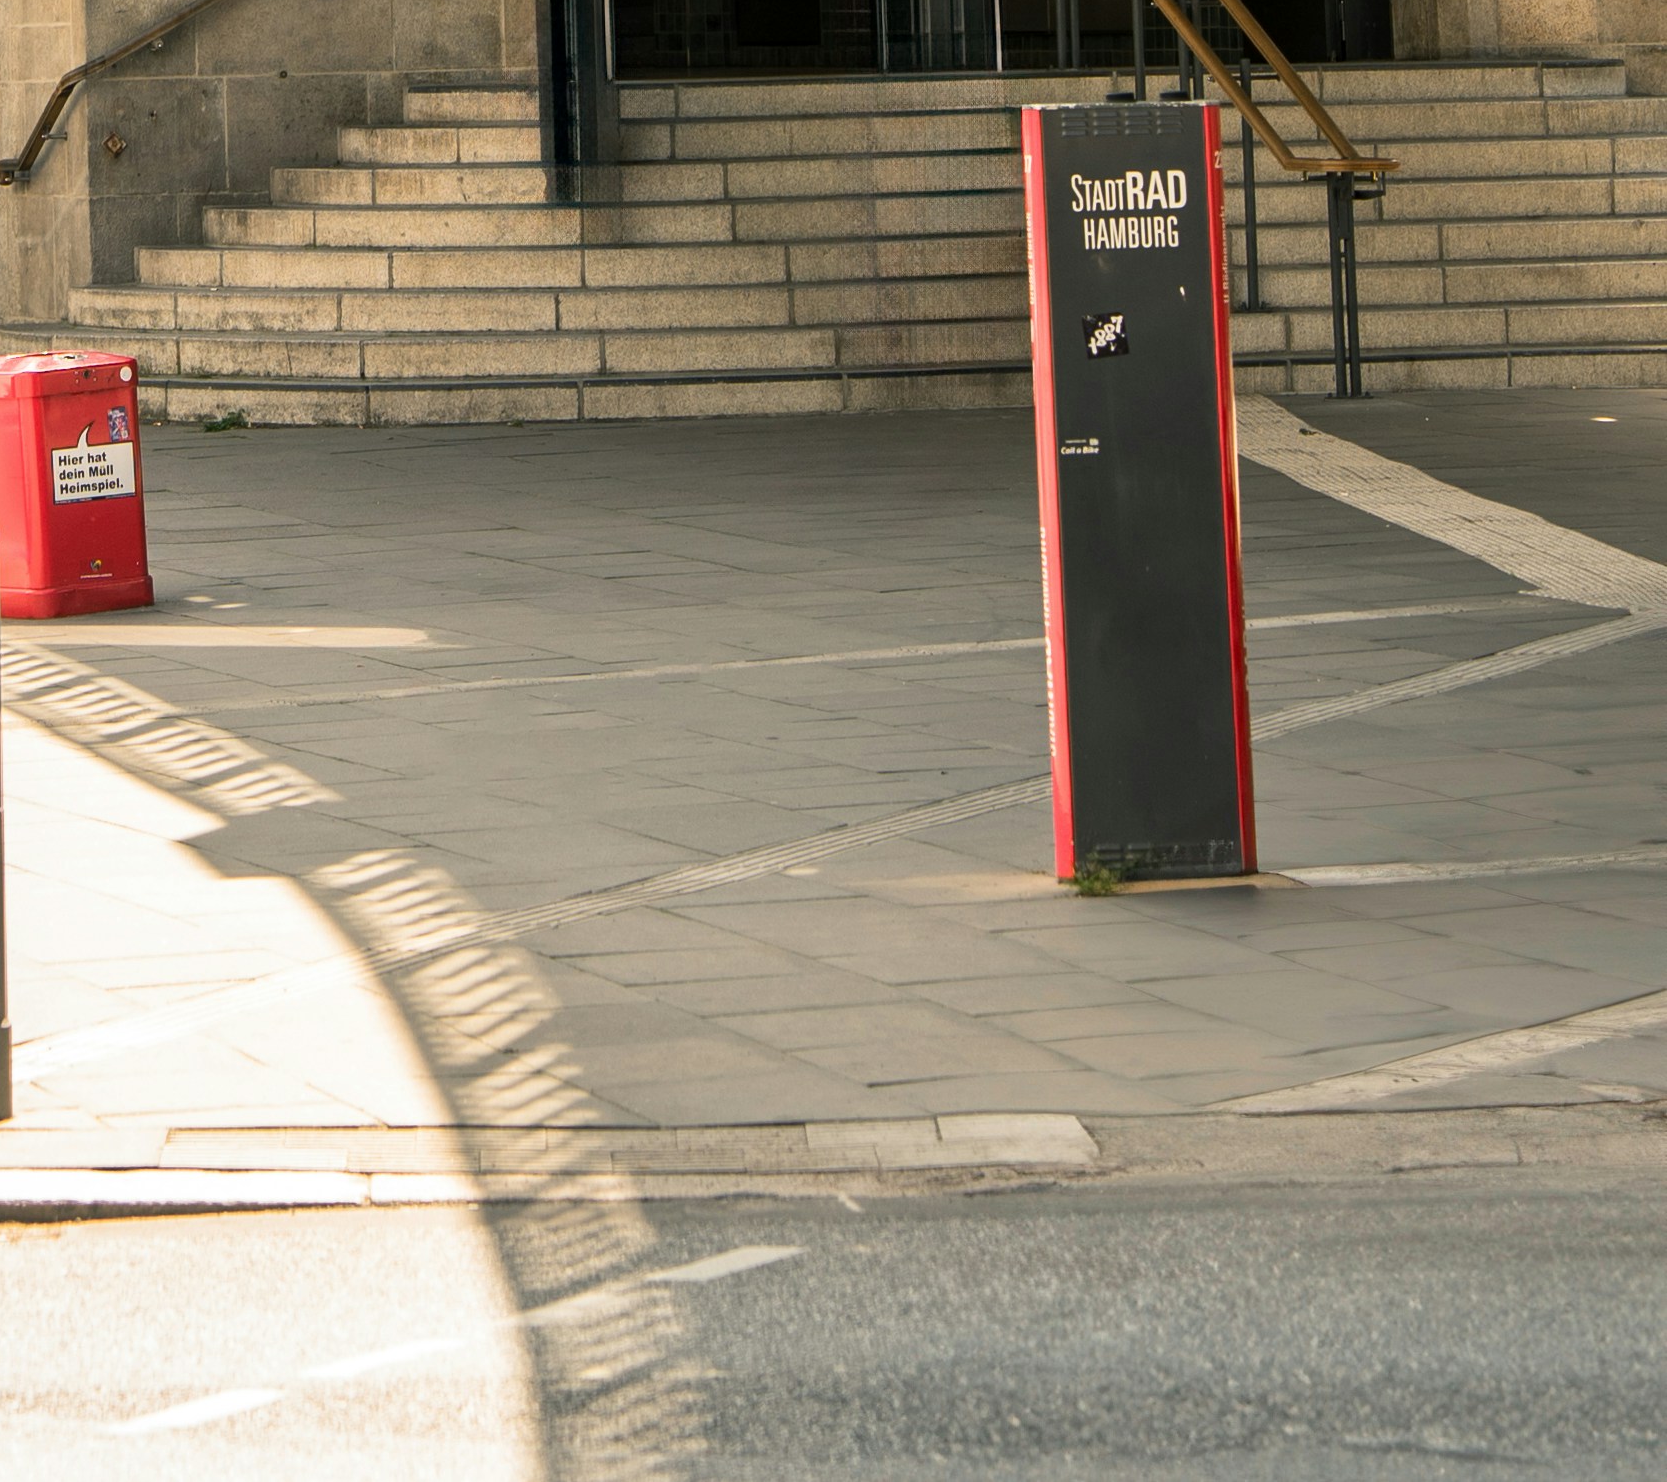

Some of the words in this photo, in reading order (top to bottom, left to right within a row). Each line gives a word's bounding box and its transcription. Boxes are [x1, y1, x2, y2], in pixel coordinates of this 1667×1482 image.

[1083, 215, 1179, 250] HAMBURG
[58, 455, 83, 466] Hier
[87, 452, 106, 463] hat
[59, 468, 85, 481] dein
[89, 465, 113, 477] Müll
[60, 478, 123, 494] Heimspiel.
